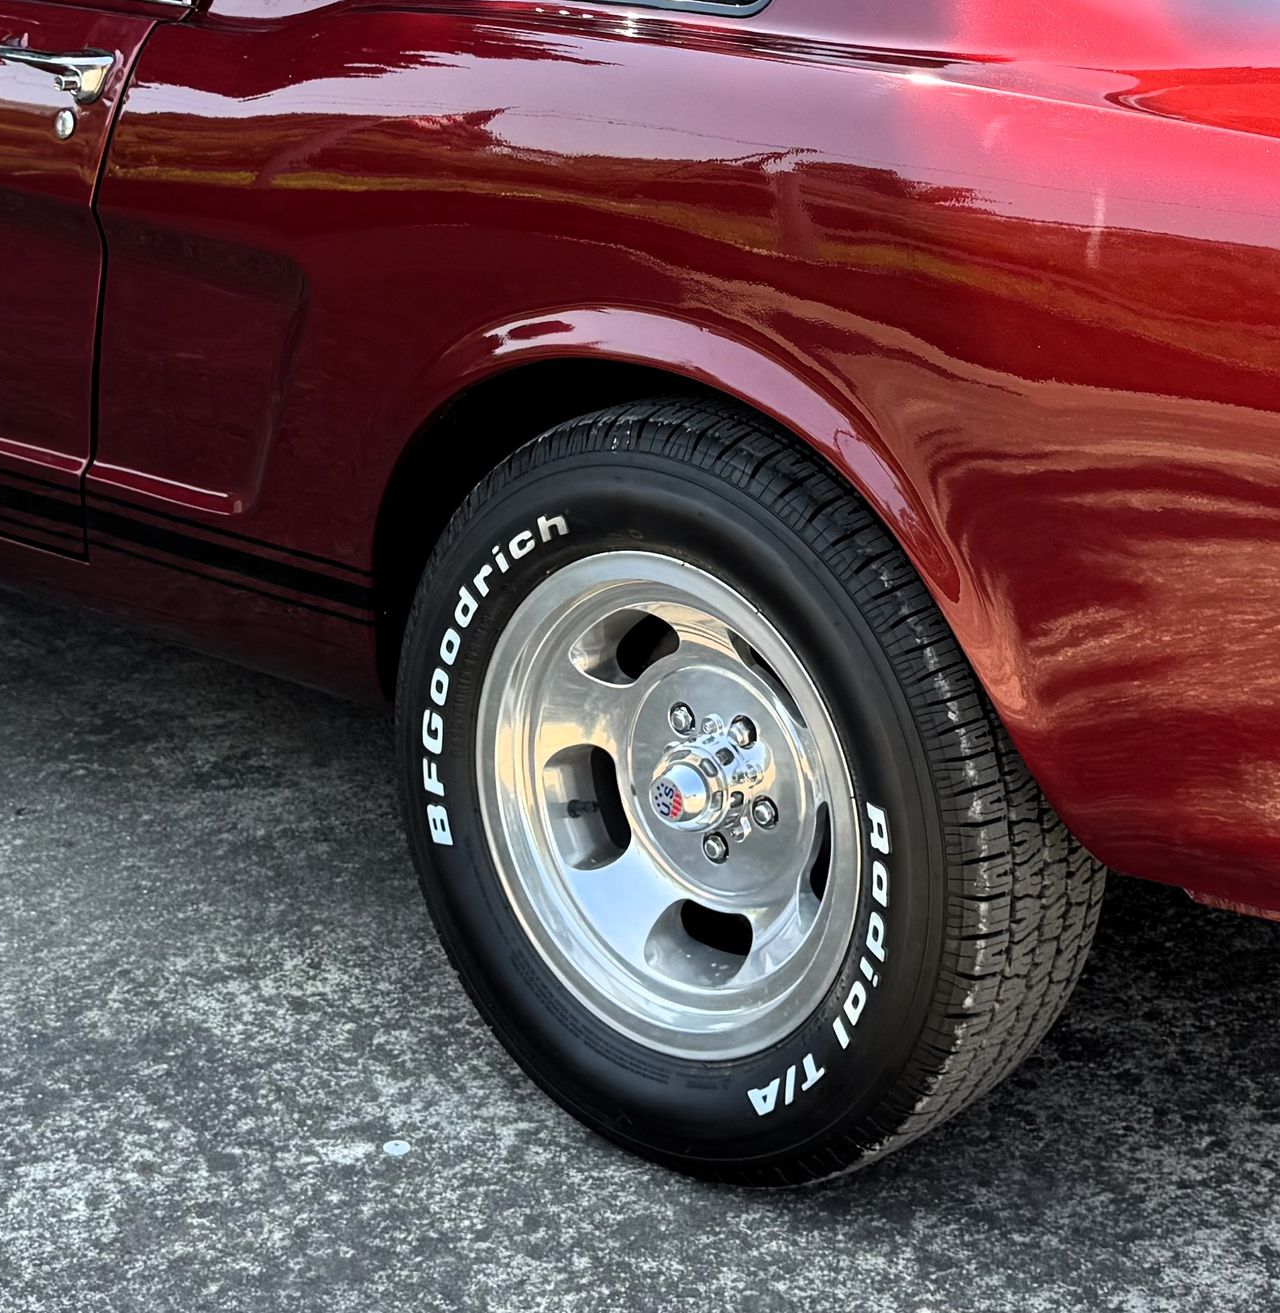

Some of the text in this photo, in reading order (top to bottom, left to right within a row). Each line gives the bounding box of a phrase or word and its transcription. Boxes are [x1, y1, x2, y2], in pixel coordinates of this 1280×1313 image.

[421, 513, 571, 847] BFGoodrich
[746, 800, 892, 1117] Radial T/A
